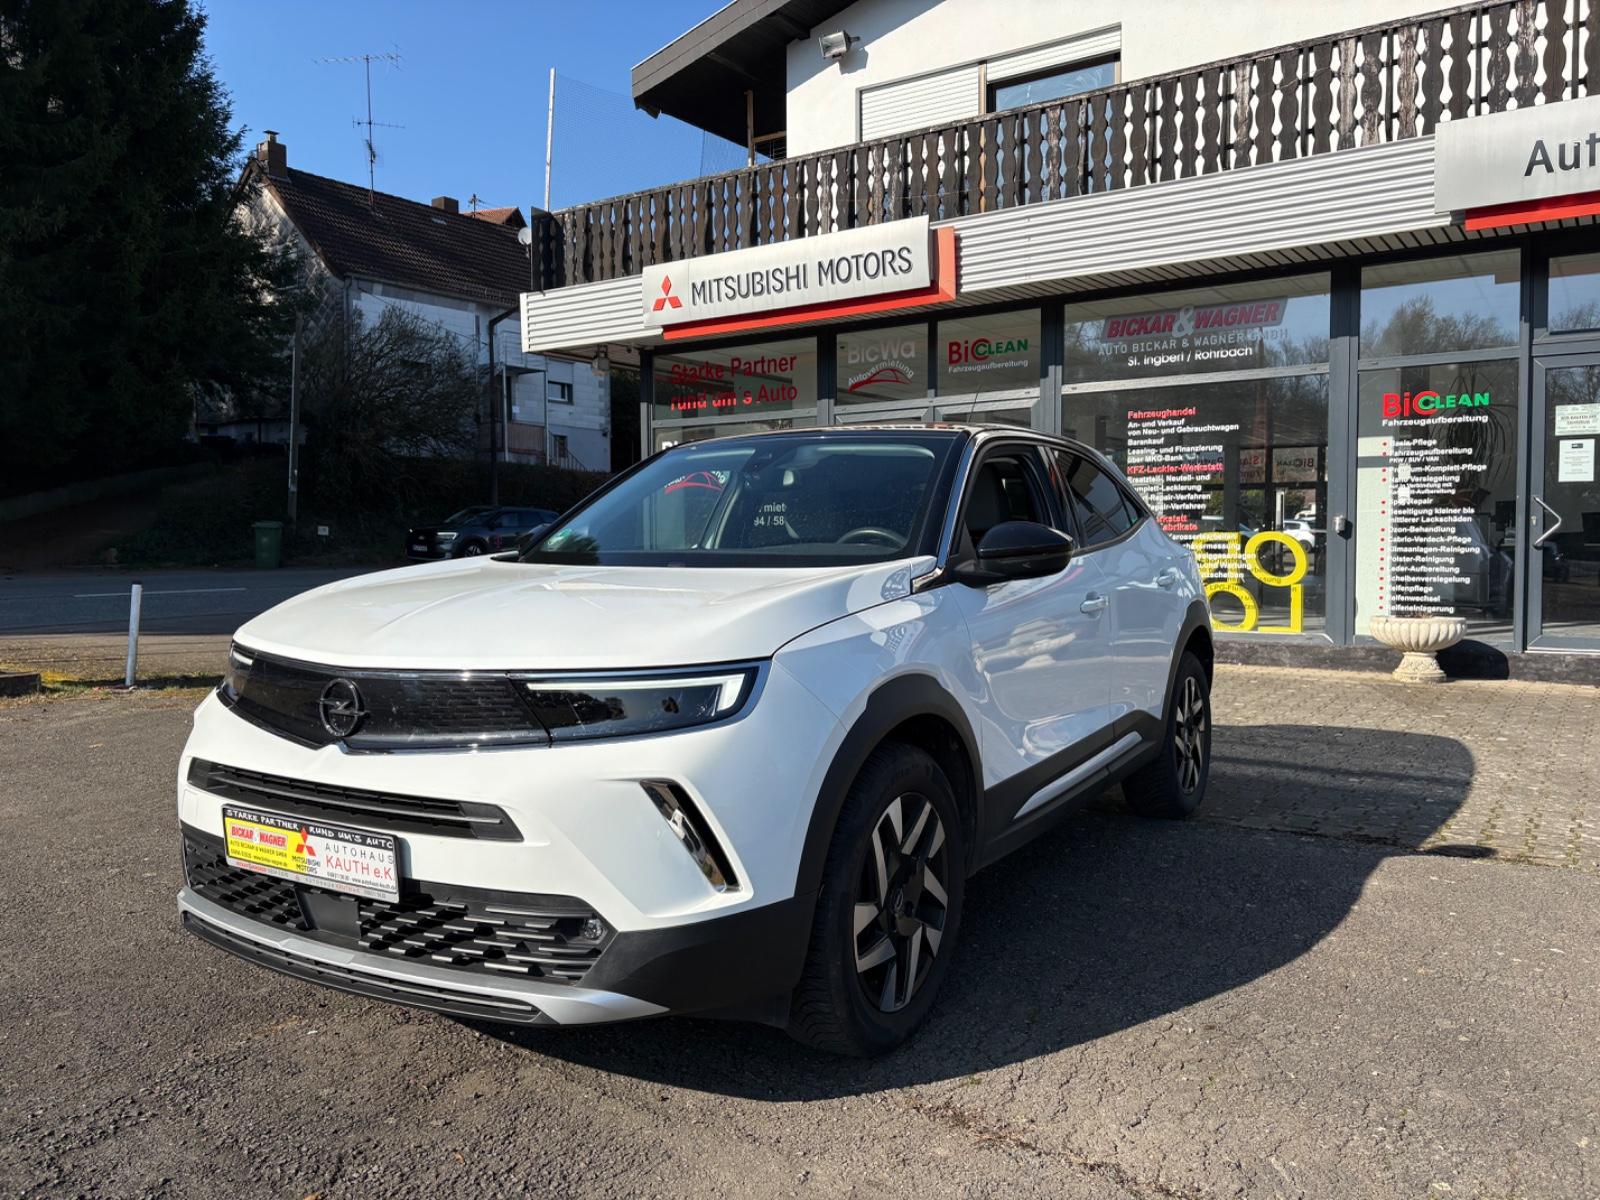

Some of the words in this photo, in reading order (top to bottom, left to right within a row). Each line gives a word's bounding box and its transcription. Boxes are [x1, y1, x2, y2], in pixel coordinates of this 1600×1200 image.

[691, 262, 809, 307] MITSUBISHI
[817, 246, 913, 287] MOTORS
[1107, 314, 1176, 338] BICKAR
[1172, 304, 1194, 338] &
[1193, 302, 1280, 329] WAGNER
[1098, 342, 1127, 356] AUTO
[1132, 339, 1176, 352] BICKAR
[1182, 338, 1190, 348] &
[1194, 333, 1244, 347] WAGNER
[848, 339, 916, 364] BicWa
[1194, 345, 1253, 360] Rohrbach
[671, 360, 725, 385] Starke
[731, 355, 798, 377] Partner
[848, 360, 915, 386] Autovermietung
[949, 359, 1029, 374] Fahrzeugaufbereitung
[670, 393, 707, 411] rund
[758, 383, 799, 404] Auto
[1127, 407, 1196, 419] Fahrzeughandel
[1157, 418, 1185, 427] Verkauf
[1382, 414, 1489, 426] Fahrzeugaufbereitung
[1176, 424, 1239, 433] Gebrauchtwagen
[1127, 437, 1164, 446] Barankauf
[1128, 447, 1158, 456] Leasing-
[1175, 444, 1223, 453] Finanzierung
[1390, 447, 1473, 456] Fahrzeugaufbereitung
[1127, 463, 1224, 474] KFZ-Lackier-Werkstatt
[1166, 474, 1194, 482] Neuteil-
[773, 516, 785, 526] 58
[1421, 515, 1472, 523] Lackschäden
[226, 809, 259, 822] STARKE
[260, 816, 299, 830] PARTNER
[309, 826, 335, 838] RUND
[338, 832, 362, 843] UM'S
[231, 826, 254, 839] BICKAR
[259, 831, 286, 847] WAGNER
[325, 843, 395, 864] AUTOHAUS
[291, 855, 321, 867] MITSUBISHI
[325, 855, 370, 876] KAUTH
[296, 864, 318, 874] MOTORS
